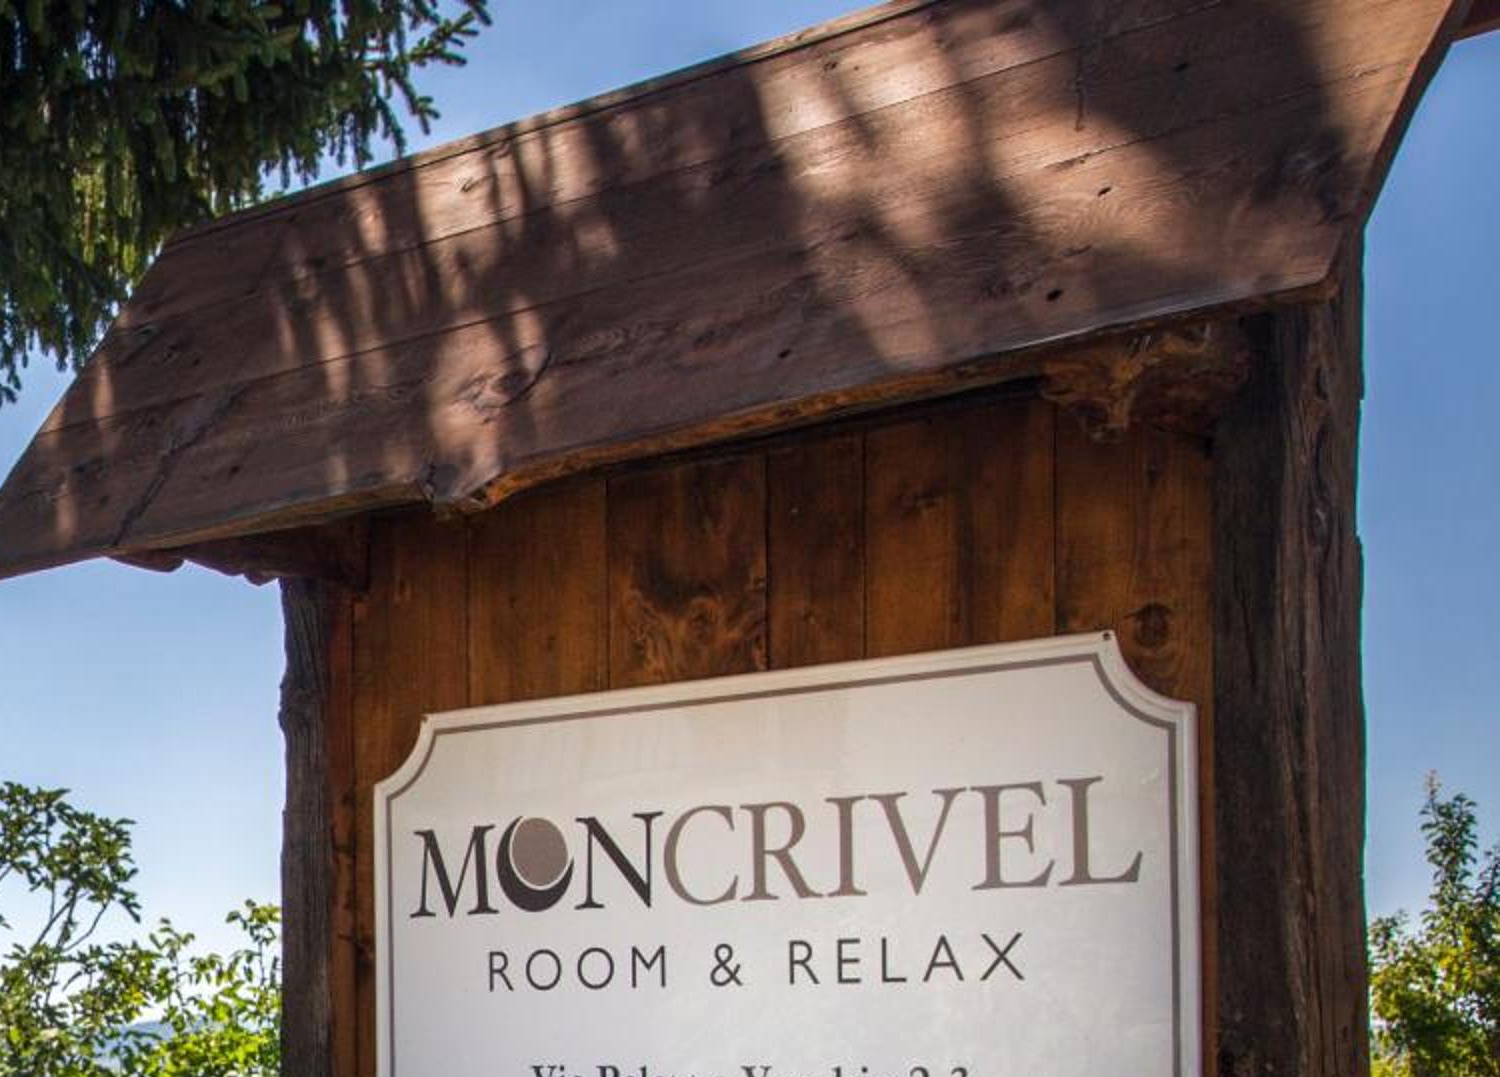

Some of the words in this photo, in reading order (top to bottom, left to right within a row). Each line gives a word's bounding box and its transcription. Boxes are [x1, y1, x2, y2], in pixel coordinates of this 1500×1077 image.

[410, 775, 1143, 918] MONCRIVEL
[489, 944, 668, 992] ROOM
[710, 942, 744, 986] &
[789, 932, 1026, 985] RELAX
